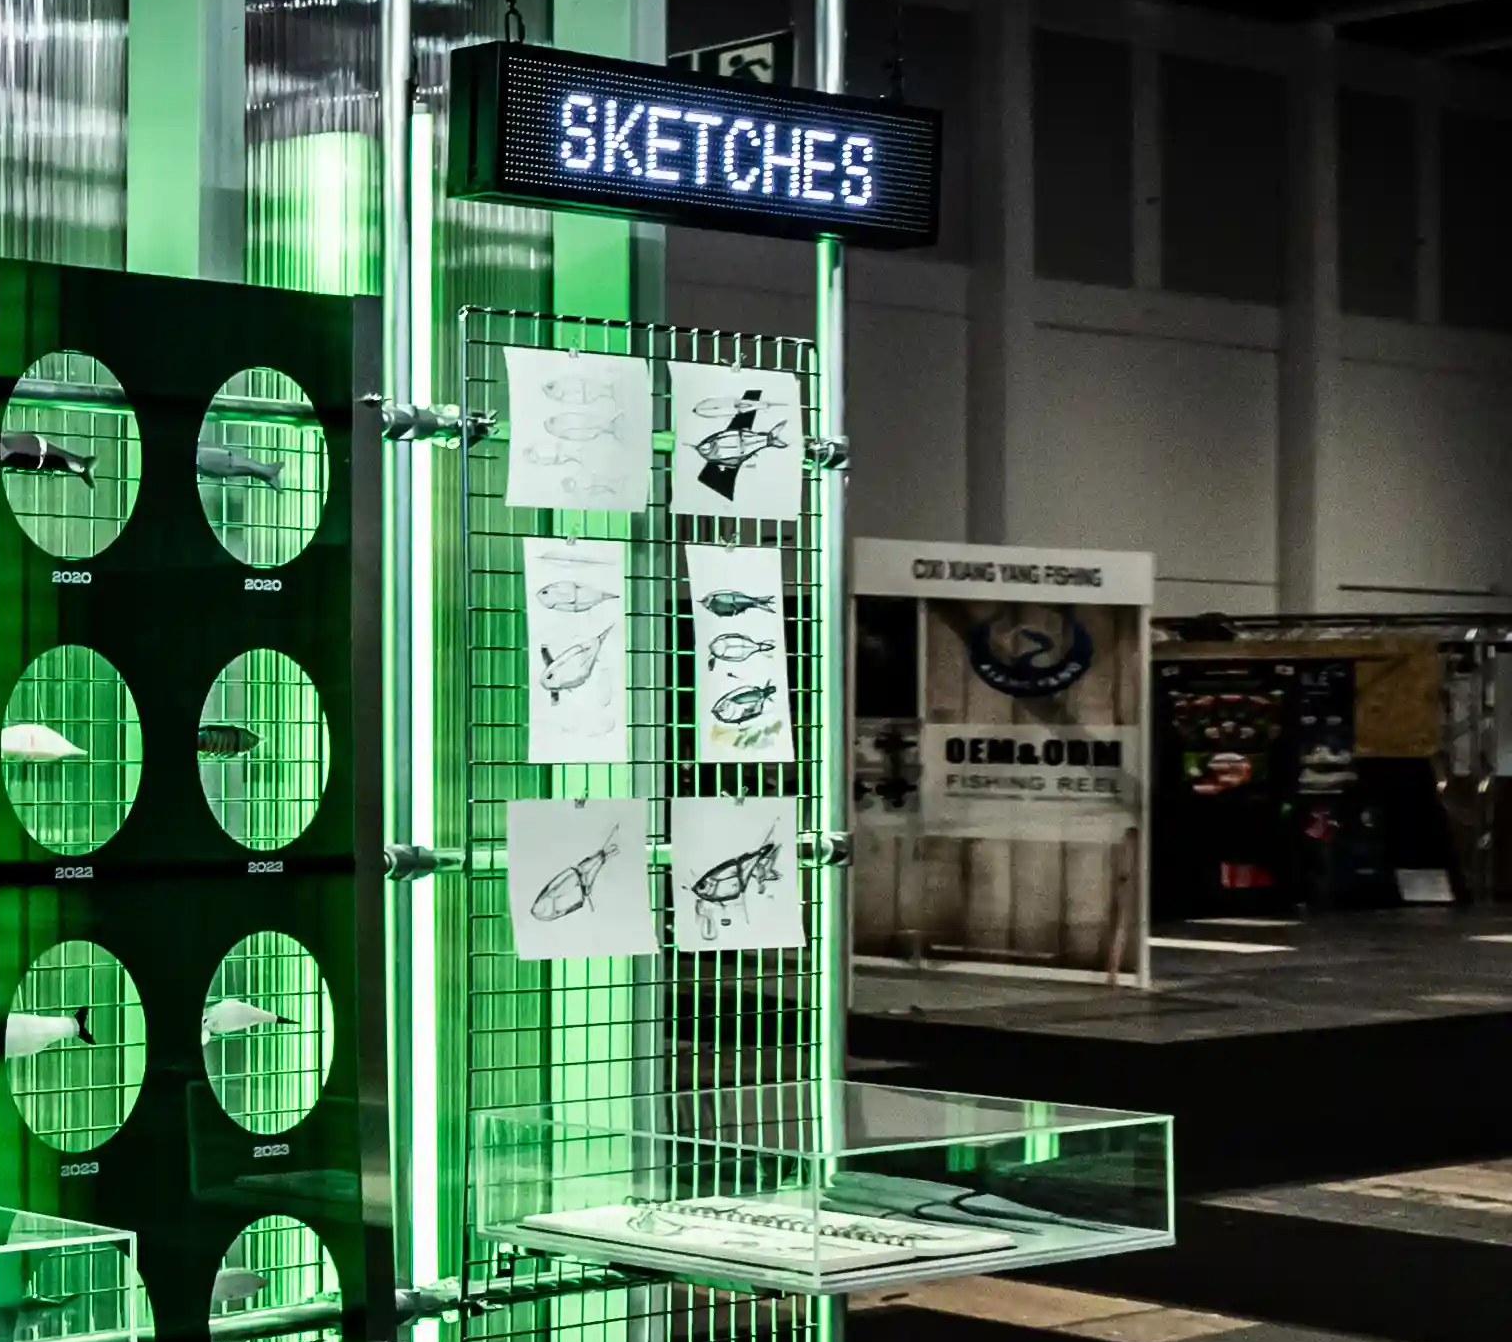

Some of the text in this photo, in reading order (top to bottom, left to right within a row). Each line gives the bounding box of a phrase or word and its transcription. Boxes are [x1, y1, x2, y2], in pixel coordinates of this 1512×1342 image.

[561, 94, 874, 206] SKETCHES
[51, 570, 92, 584] 2020
[998, 563, 1040, 585] YANG
[1044, 565, 1103, 588] FISHING
[243, 578, 283, 592] 2020
[946, 773, 1123, 794] FISHING REEL
[60, 1161, 100, 1177] 2023
